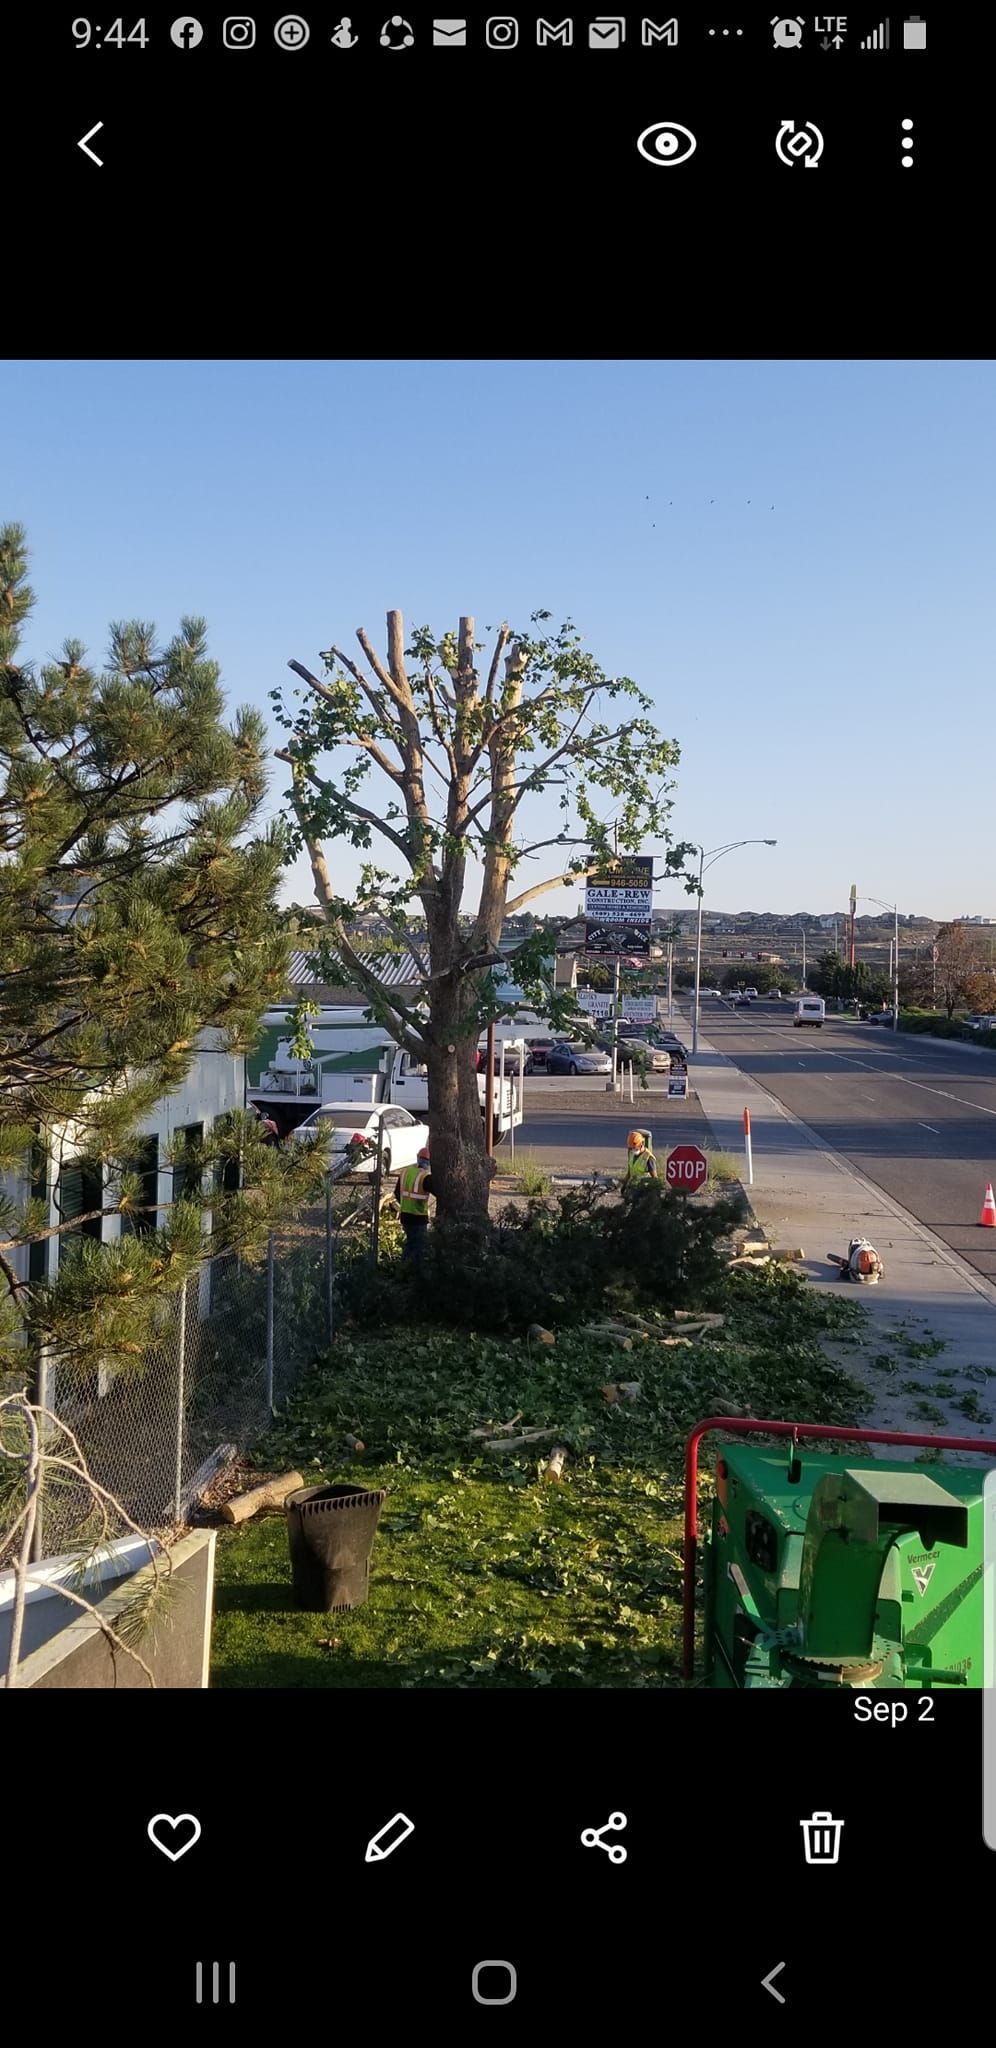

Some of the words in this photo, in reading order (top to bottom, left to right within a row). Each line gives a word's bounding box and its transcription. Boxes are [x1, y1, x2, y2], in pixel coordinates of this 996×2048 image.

[610, 879, 649, 887] 946-5050
[587, 889, 651, 898] GALE-REW
[667, 1160, 705, 1179] STOP
[907, 1551, 940, 1564] Vermeer
